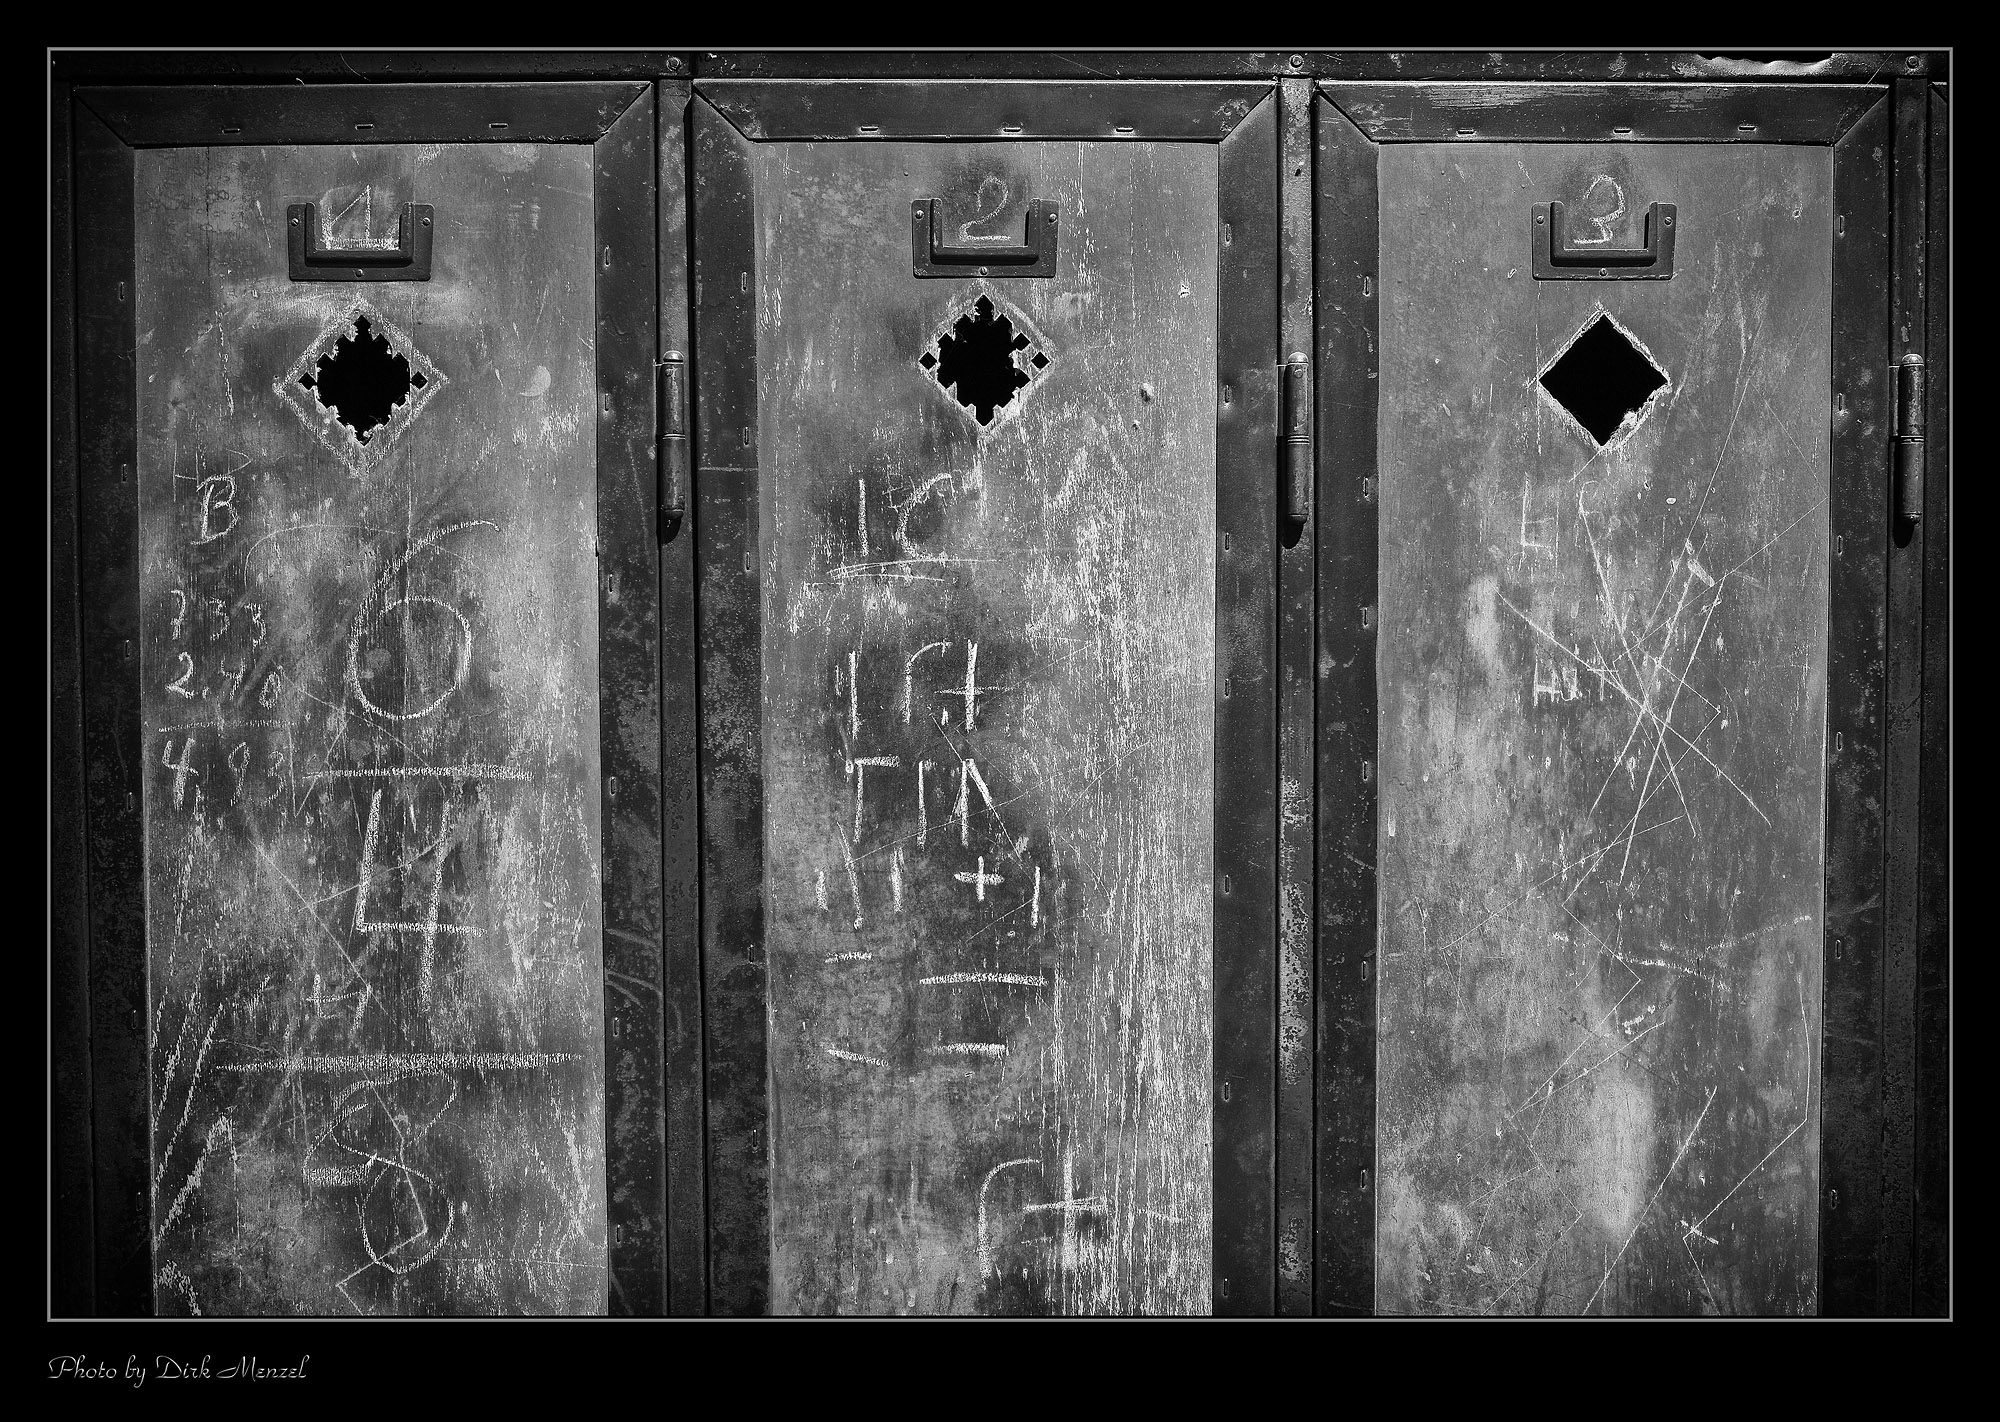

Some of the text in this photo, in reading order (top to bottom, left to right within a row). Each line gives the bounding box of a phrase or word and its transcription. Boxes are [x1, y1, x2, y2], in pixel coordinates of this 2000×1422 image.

[959, 175, 1012, 242] 2
[1573, 173, 1626, 246] 3
[190, 474, 240, 546] B
[347, 519, 501, 721] 6
